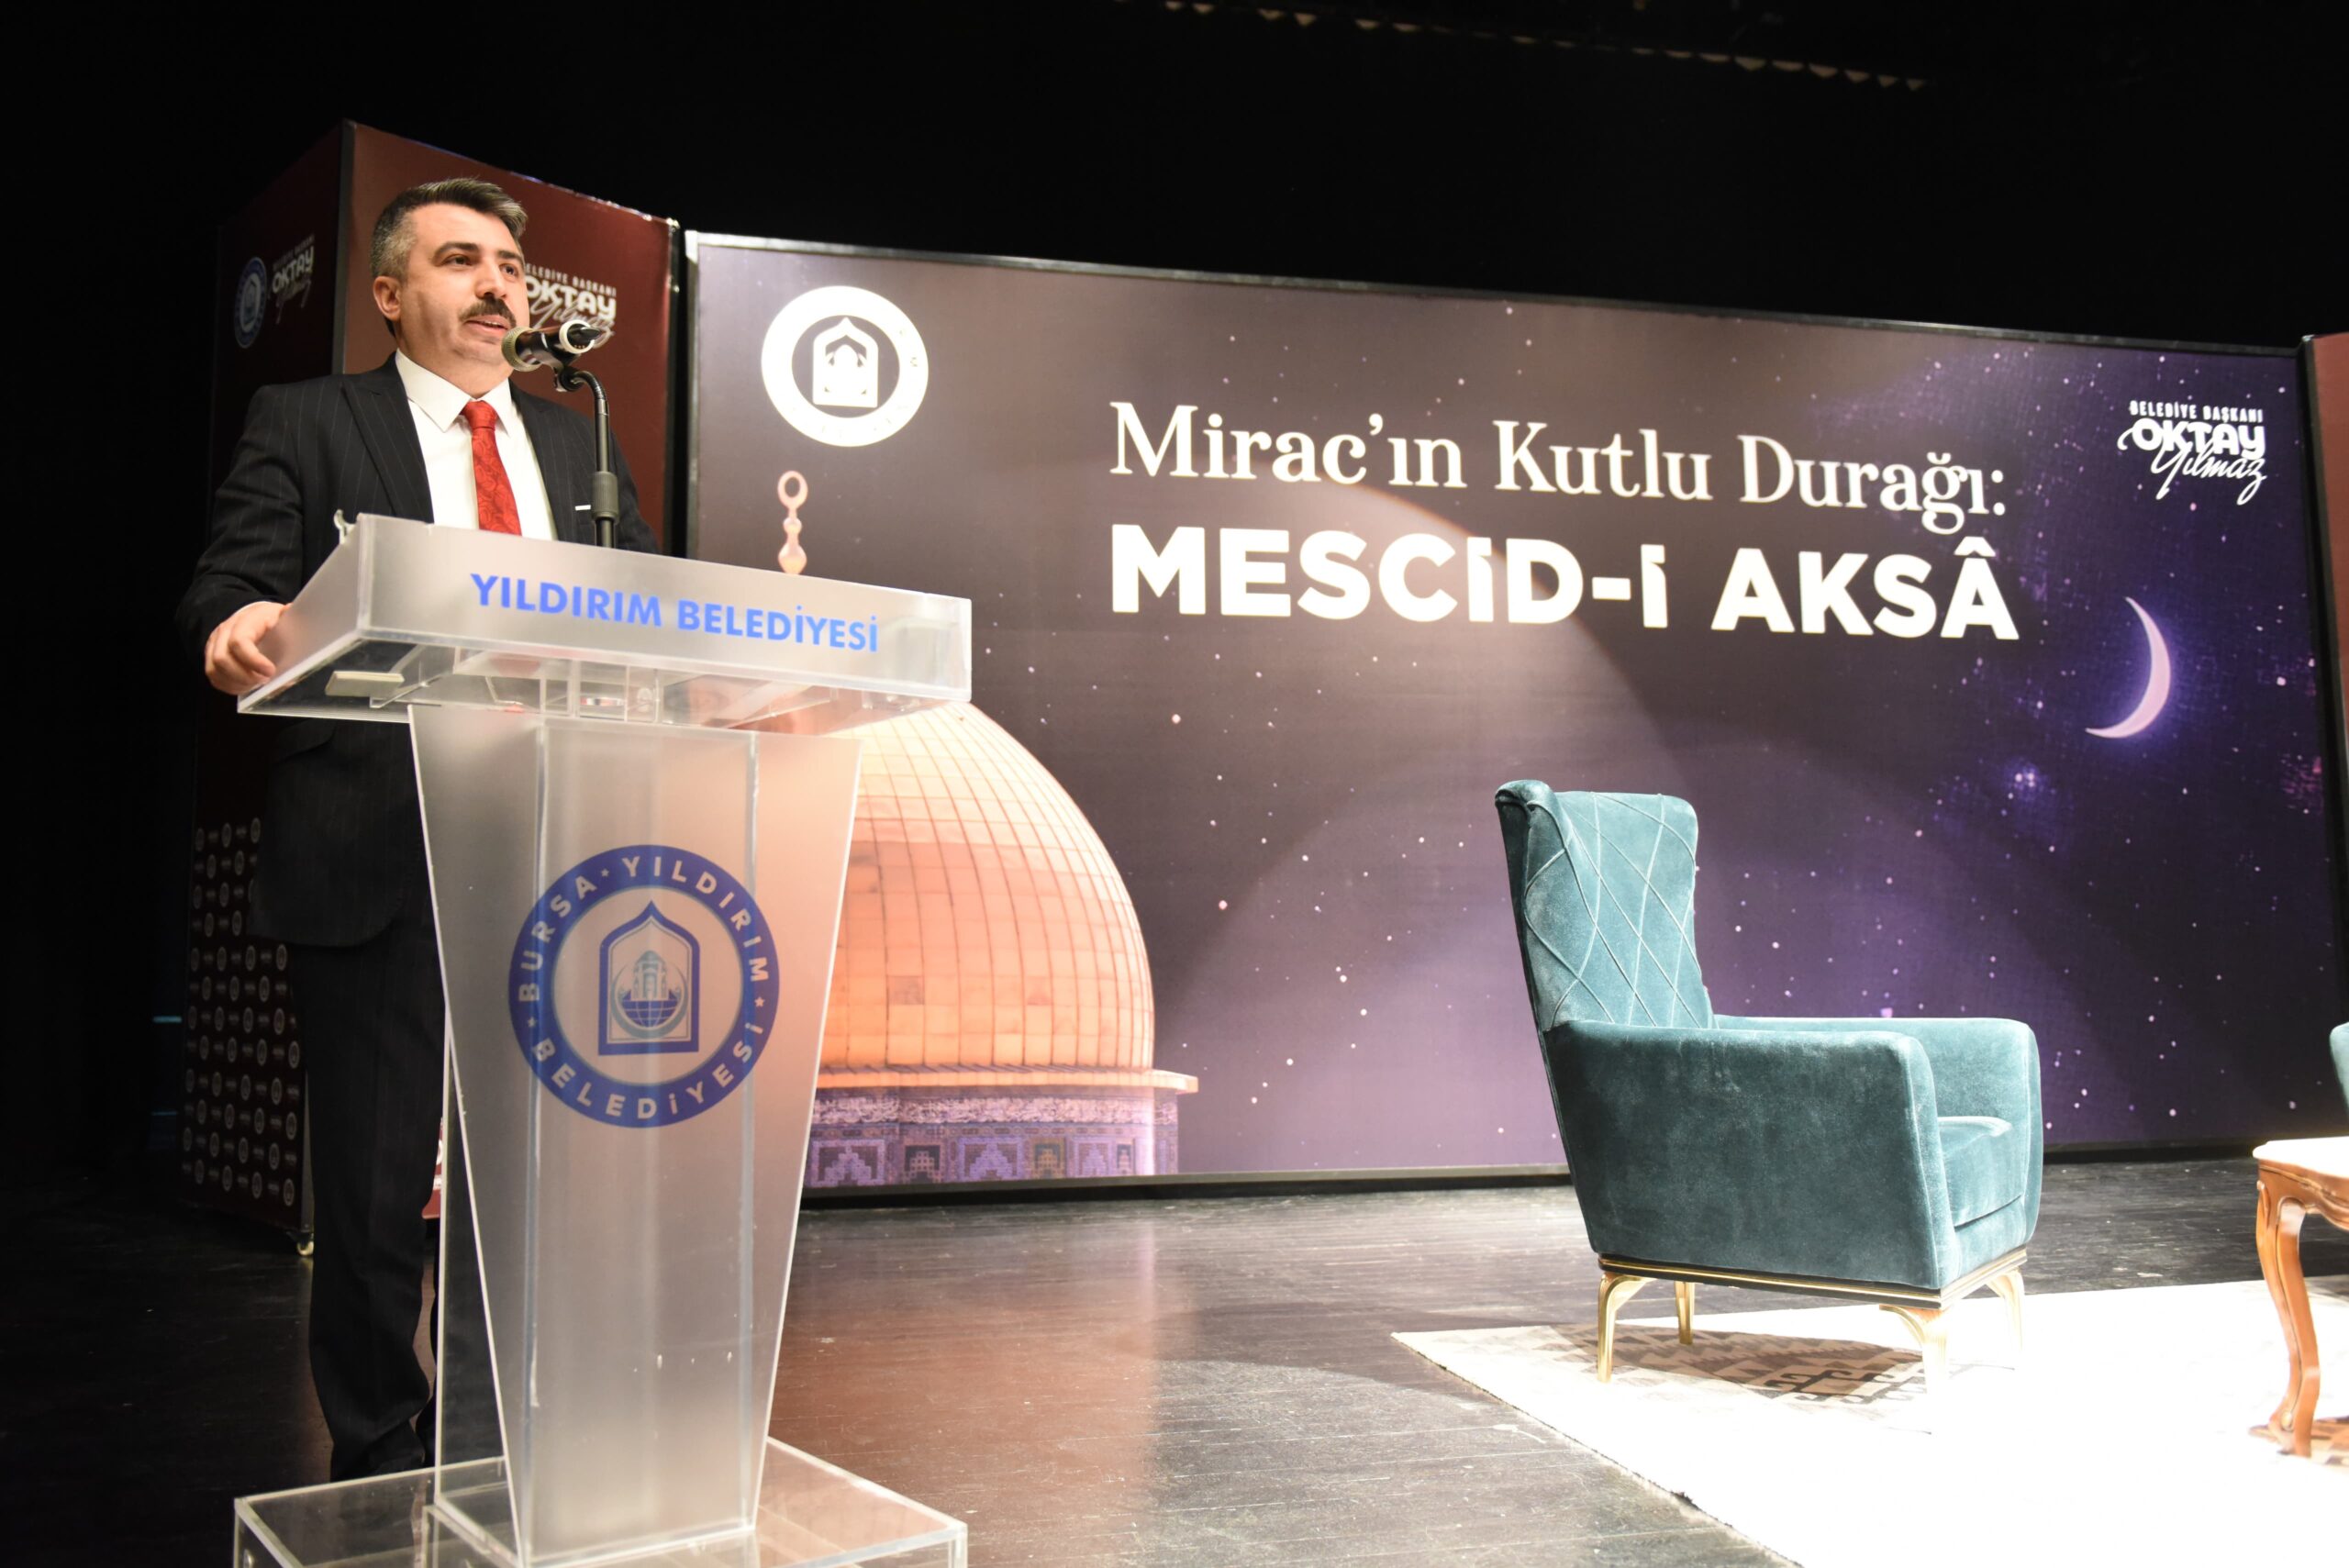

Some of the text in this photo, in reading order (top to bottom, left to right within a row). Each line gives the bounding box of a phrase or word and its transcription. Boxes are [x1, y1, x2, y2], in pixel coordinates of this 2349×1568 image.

[524, 262, 568, 284] ELEDİYE
[2129, 400, 2263, 424] BELEDİYE BAŞKANI
[2131, 417, 2266, 460] OKTAY
[1494, 419, 1710, 500] Kutlu
[1741, 435, 2006, 535] Durağı:
[471, 573, 879, 652] YILDIRIM BELEDİYESİ
[1111, 523, 2020, 640] MESCİD-İ AKSÂ
[518, 855, 770, 1003] BURSA YILDIRIM
[531, 1021, 764, 1120] BELEDİYESİ
